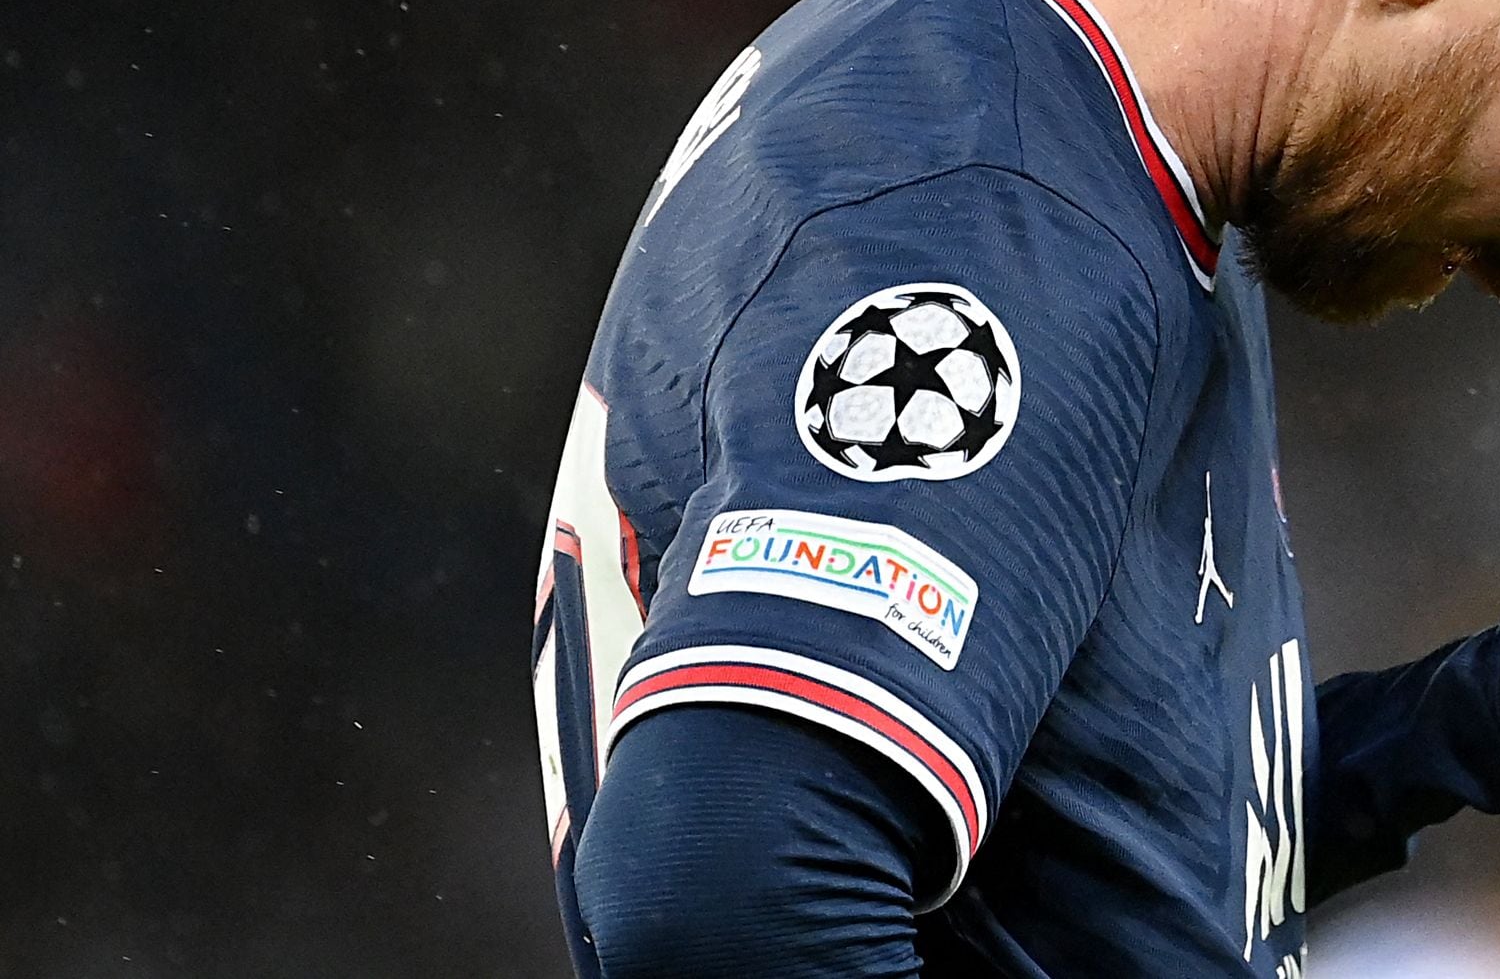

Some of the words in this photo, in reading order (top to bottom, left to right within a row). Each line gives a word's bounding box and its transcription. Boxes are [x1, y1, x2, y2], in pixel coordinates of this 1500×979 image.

[716, 516, 775, 535] UEFA
[884, 603, 904, 620] for
[907, 620, 952, 659] children
